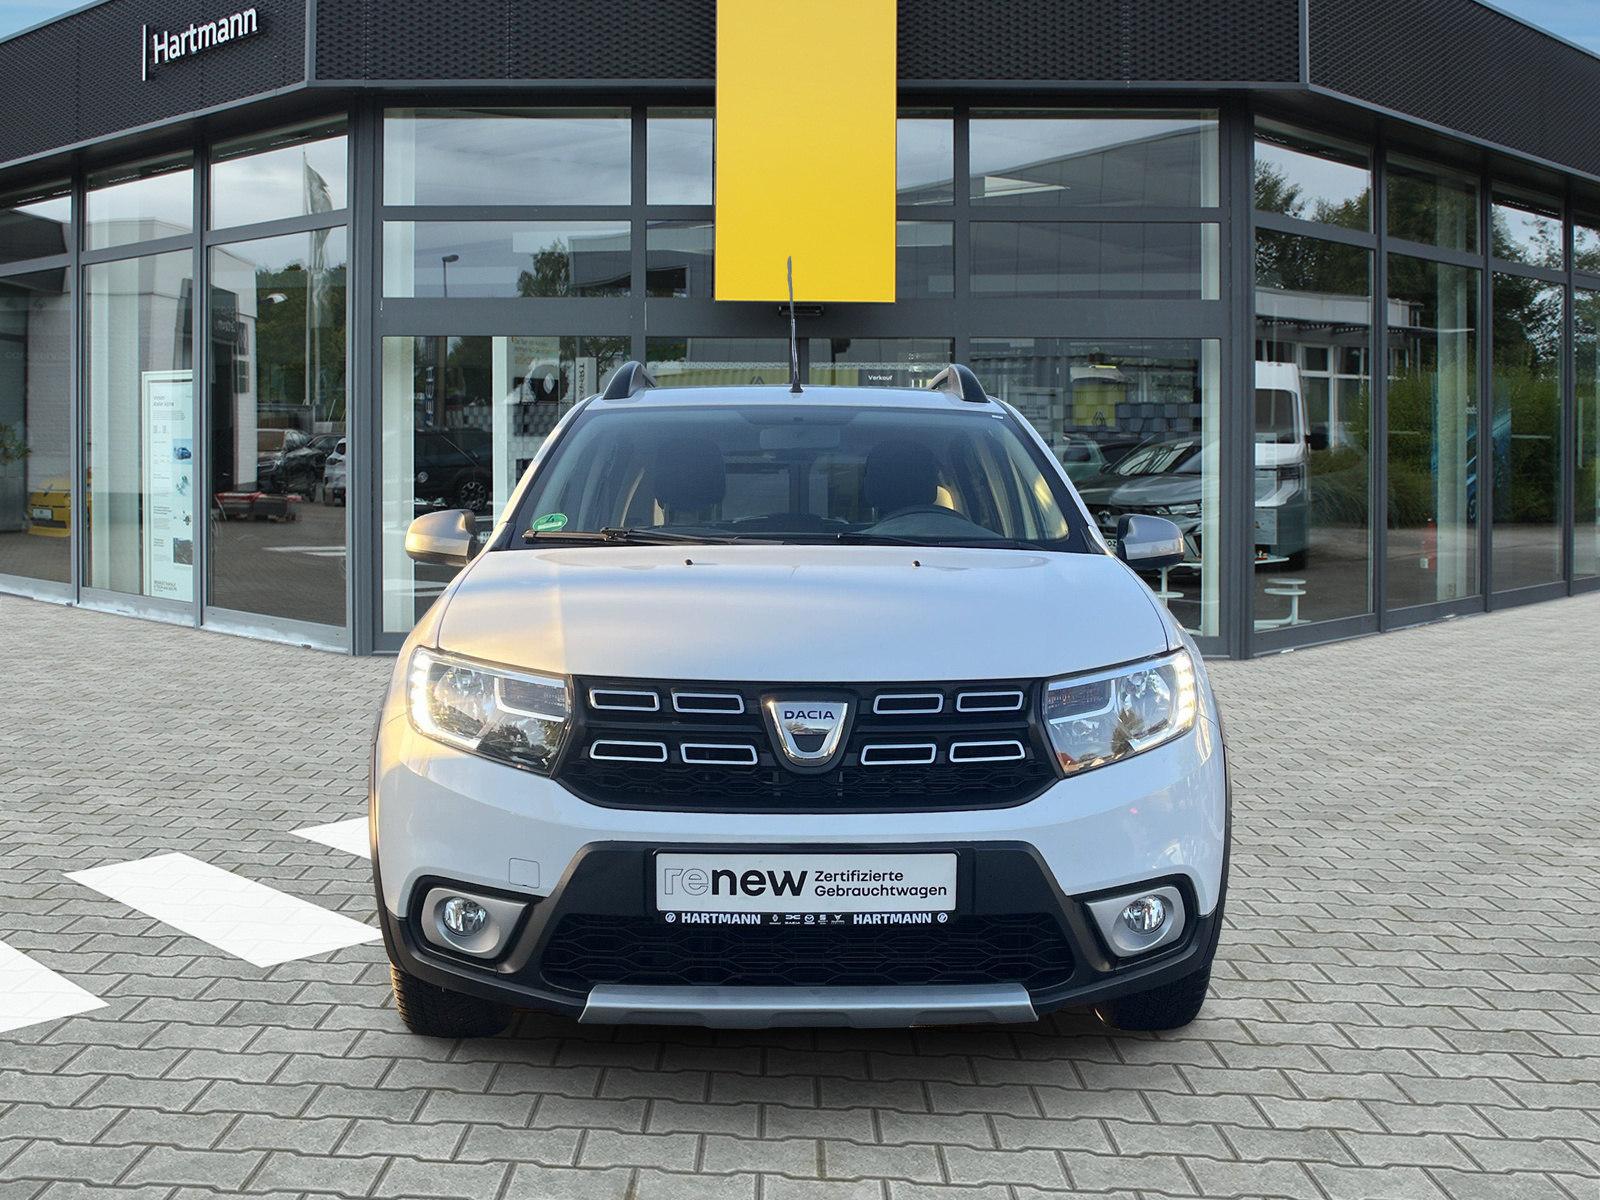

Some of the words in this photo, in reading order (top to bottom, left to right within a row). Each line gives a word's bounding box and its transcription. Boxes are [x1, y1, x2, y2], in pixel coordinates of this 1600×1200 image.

[153, 8, 258, 64] Hartmann
[784, 710, 834, 720] DACIA
[664, 868, 808, 897] renew
[814, 870, 904, 882] Zertifizierte
[814, 884, 948, 899] Gebrauchtwagen
[681, 912, 761, 925] HARTMANN
[853, 912, 932, 925] HARTMANN
